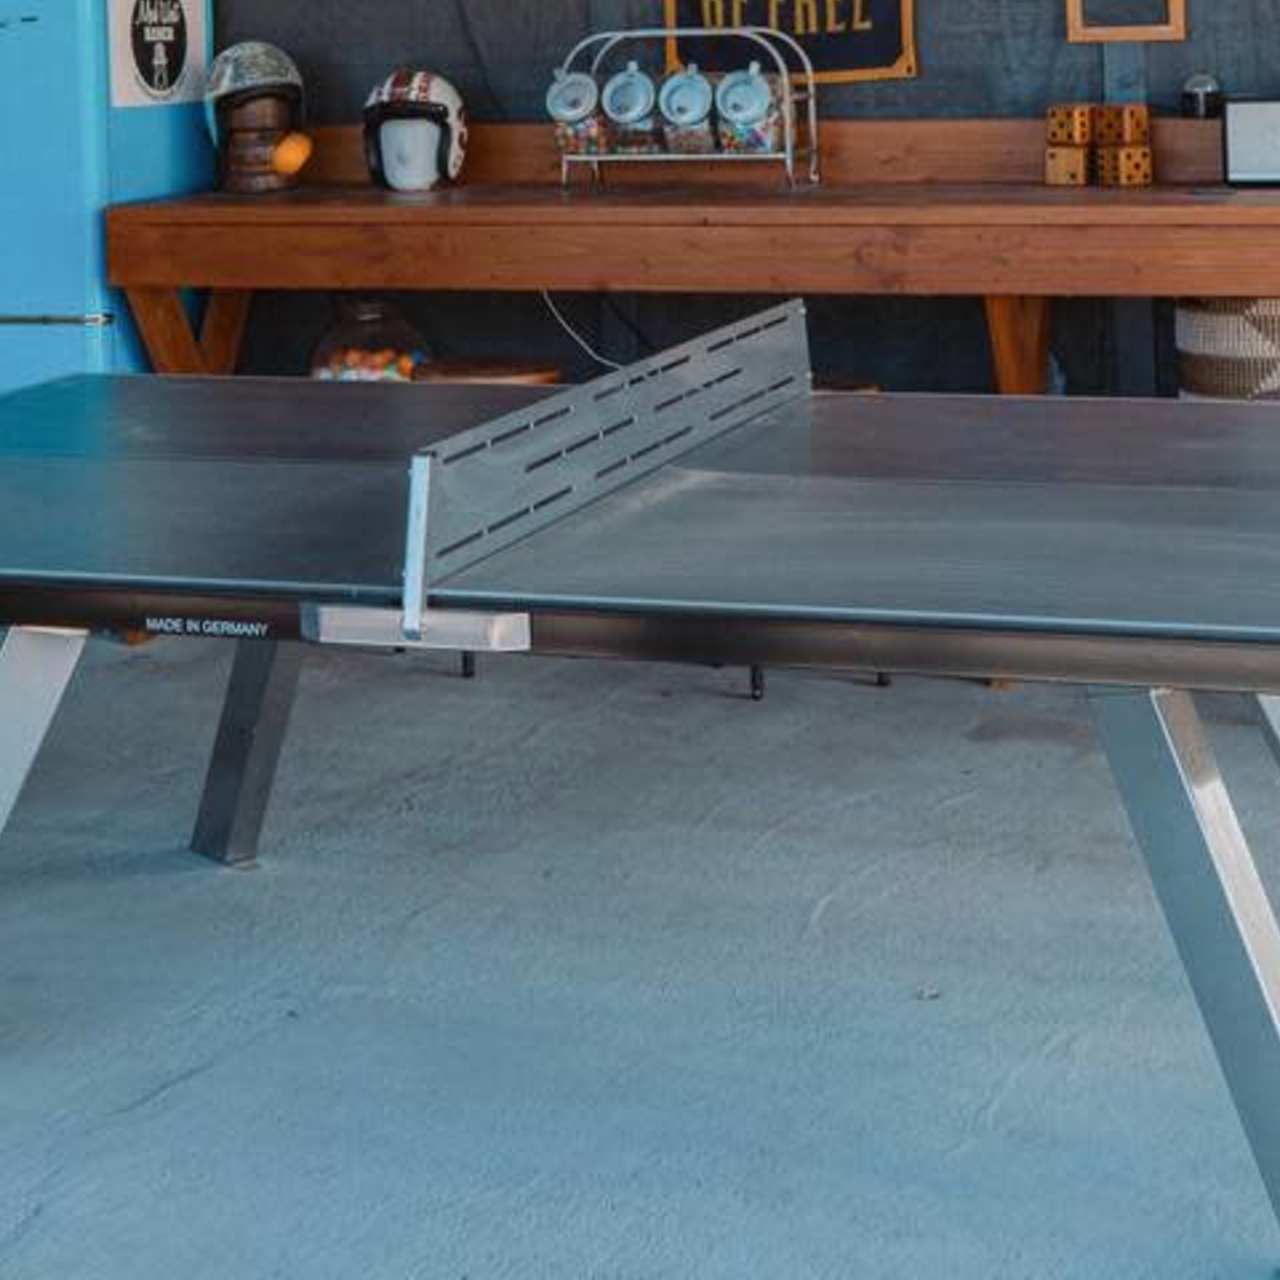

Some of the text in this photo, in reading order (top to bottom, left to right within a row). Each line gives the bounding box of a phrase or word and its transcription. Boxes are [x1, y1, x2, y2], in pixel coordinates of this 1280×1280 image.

[145, 617, 268, 637] MADE IN GERMANY
